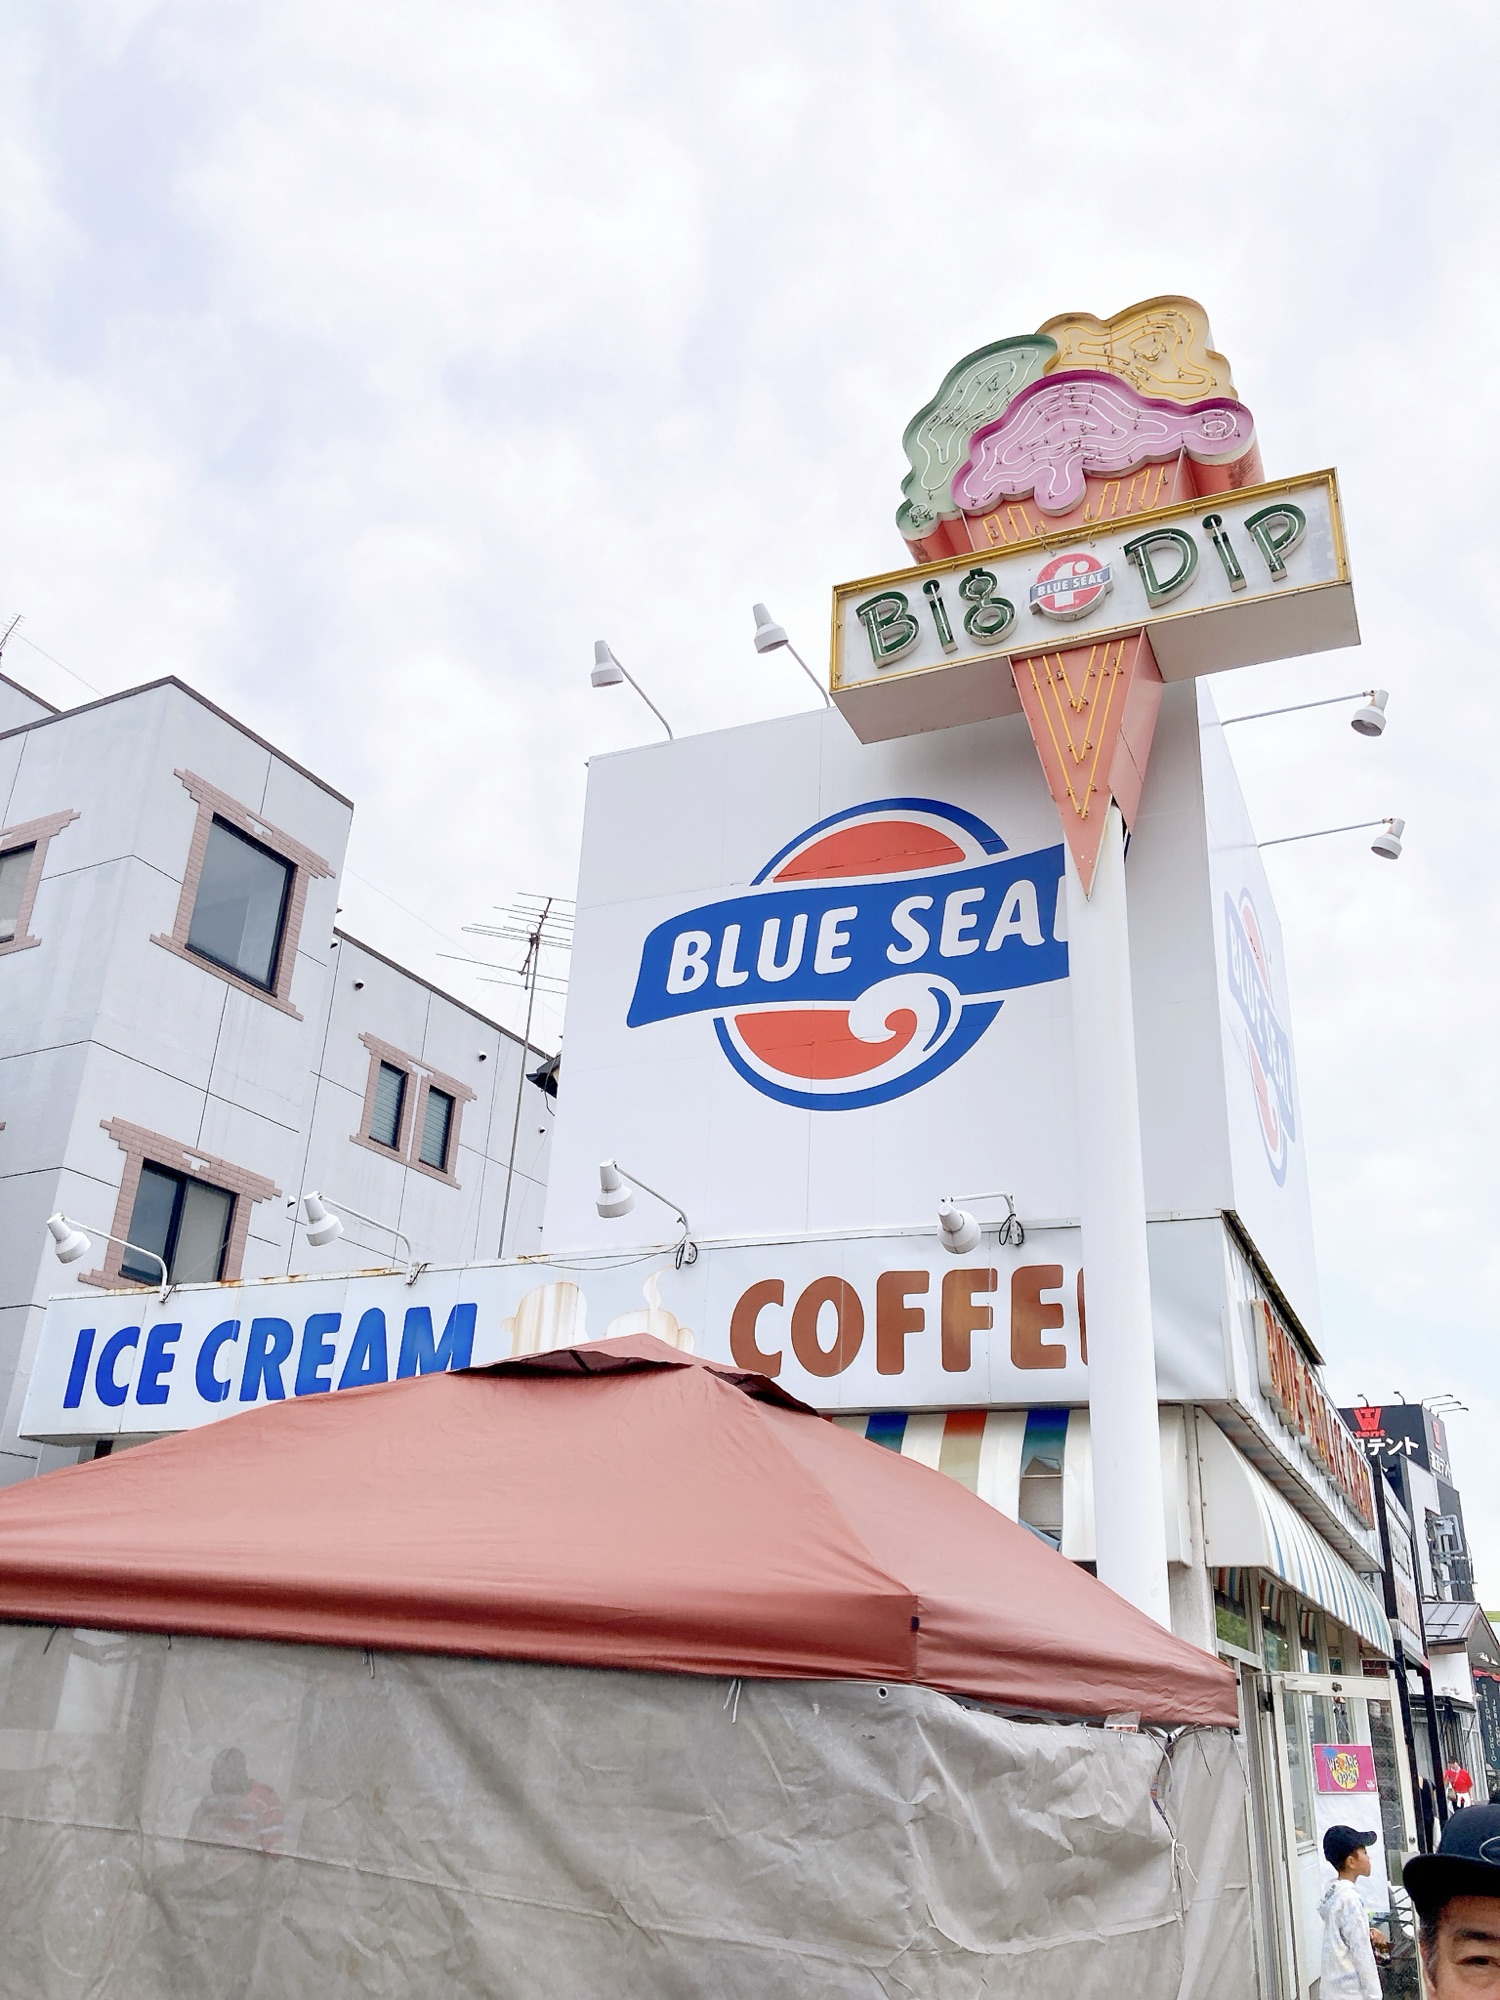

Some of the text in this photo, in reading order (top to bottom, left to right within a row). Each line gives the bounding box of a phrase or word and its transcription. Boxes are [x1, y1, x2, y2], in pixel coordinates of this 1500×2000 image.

[1037, 573, 1103, 596] BLUE SEAL
[667, 905, 858, 995] BLUE
[1229, 915, 1292, 1116] BLUE SEAL
[63, 1302, 478, 1408] ICE CREAM
[730, 1265, 1088, 1378] COFFE
[1327, 1757, 1340, 1771] WE
